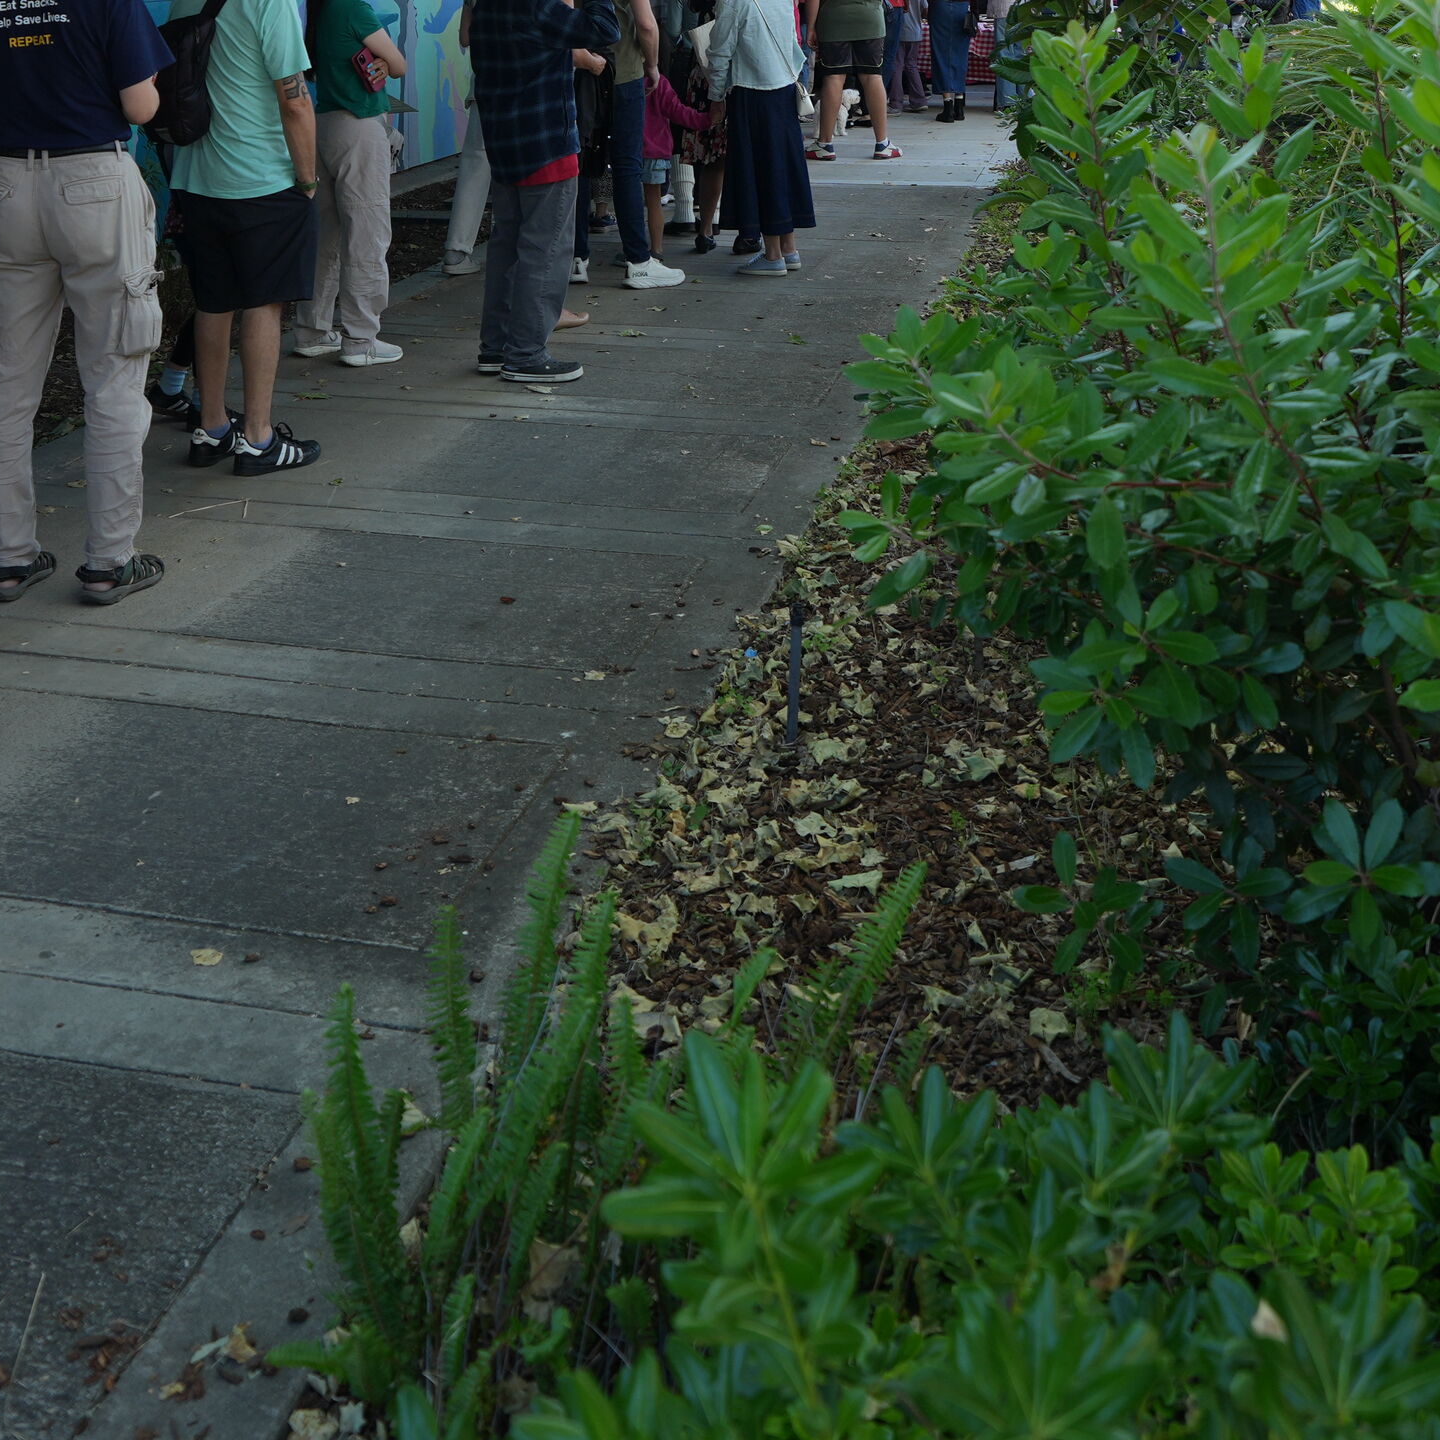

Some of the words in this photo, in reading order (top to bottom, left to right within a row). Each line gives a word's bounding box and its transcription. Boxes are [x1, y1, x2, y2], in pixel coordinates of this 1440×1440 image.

[15, 15, 41, 25] Save
[43, 12, 70, 23] Lives.
[9, 34, 54, 48] REPEAT.
